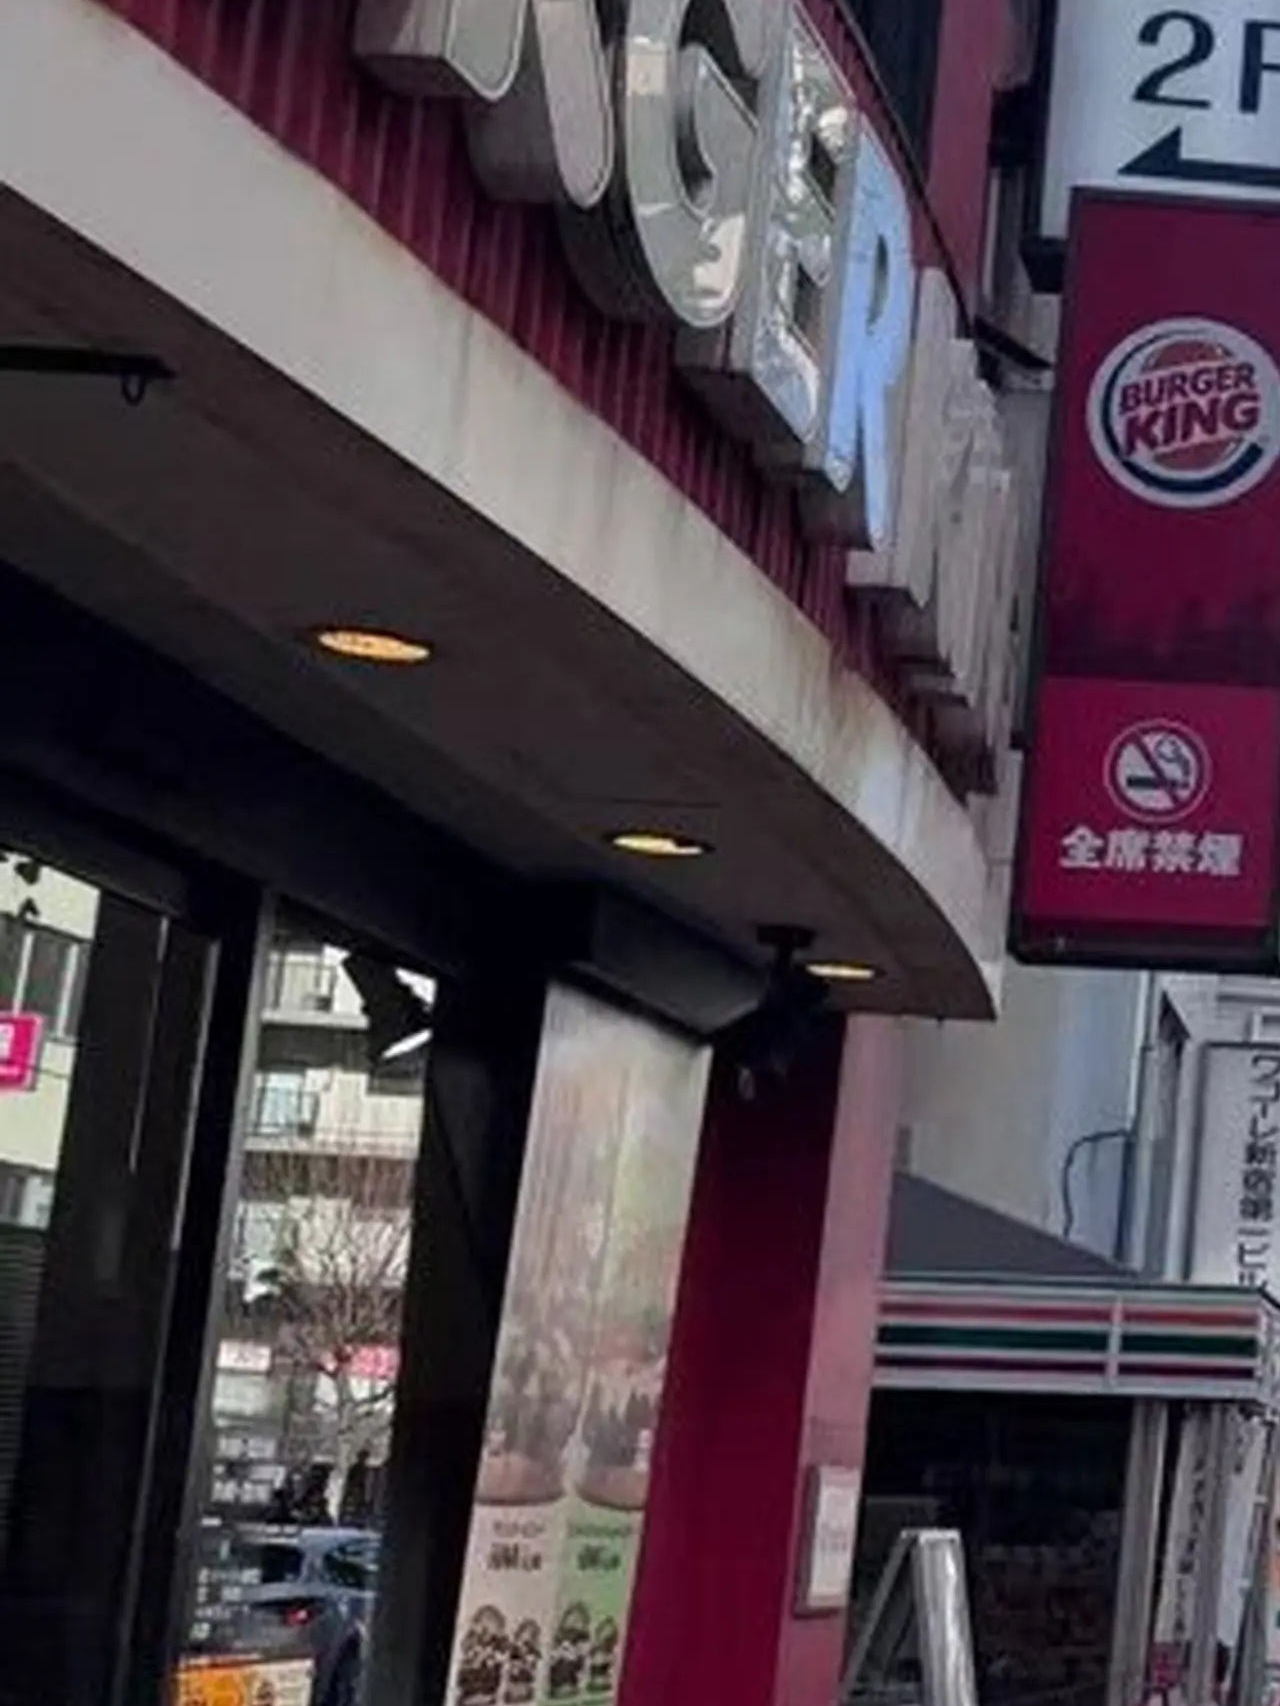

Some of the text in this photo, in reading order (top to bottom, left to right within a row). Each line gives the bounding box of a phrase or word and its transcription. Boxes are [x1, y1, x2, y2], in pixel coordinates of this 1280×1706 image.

[1117, 359, 1257, 417] BURGER
[1122, 390, 1263, 456] KING
[1060, 824, 1244, 877] 全席禁煙
